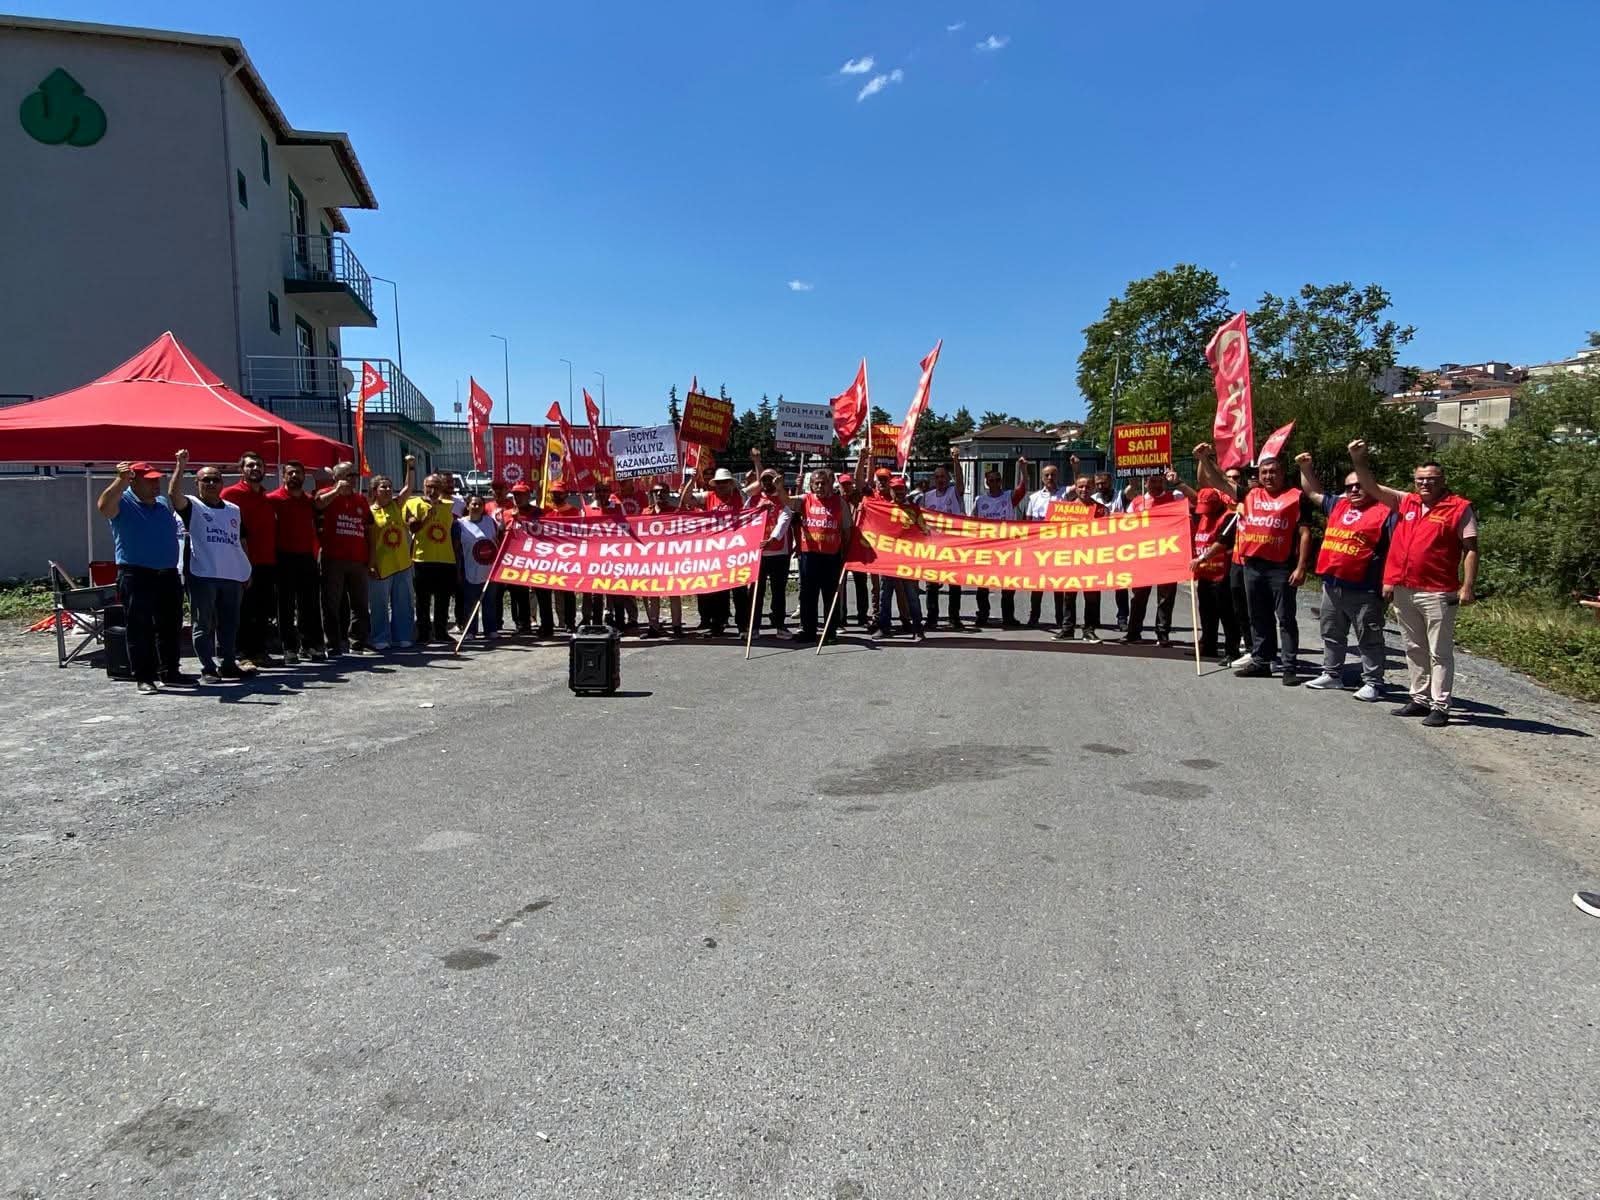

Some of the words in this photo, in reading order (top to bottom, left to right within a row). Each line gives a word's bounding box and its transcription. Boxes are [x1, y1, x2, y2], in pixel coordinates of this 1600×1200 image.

[781, 421, 802, 429] ATILAN
[1118, 425, 1167, 439] KAHROLSUN
[505, 436, 525, 456] BU
[1127, 439, 1158, 452] SARI
[616, 453, 677, 469] KAZANACAĞIZ
[1117, 452, 1169, 466] SENDİKACILIK
[1053, 503, 1089, 516] YAŞASIN
[1039, 510, 1150, 541] BİRLİĞİ
[523, 537, 589, 559] İŞÇİ
[599, 534, 747, 558] KIYIMINA
[860, 530, 1023, 567] SERMAYEYİ
[1033, 535, 1181, 567] YENECEK
[502, 553, 582, 575] SENDİKA
[587, 556, 722, 578] DÜŞMANLIĞINA
[726, 550, 760, 569] SON
[499, 567, 567, 587] DİSK
[591, 566, 752, 592] NAKLİYAT-İŞ
[896, 565, 959, 584] DİSK
[966, 571, 1133, 590] NAKLİYAT-İŞ
